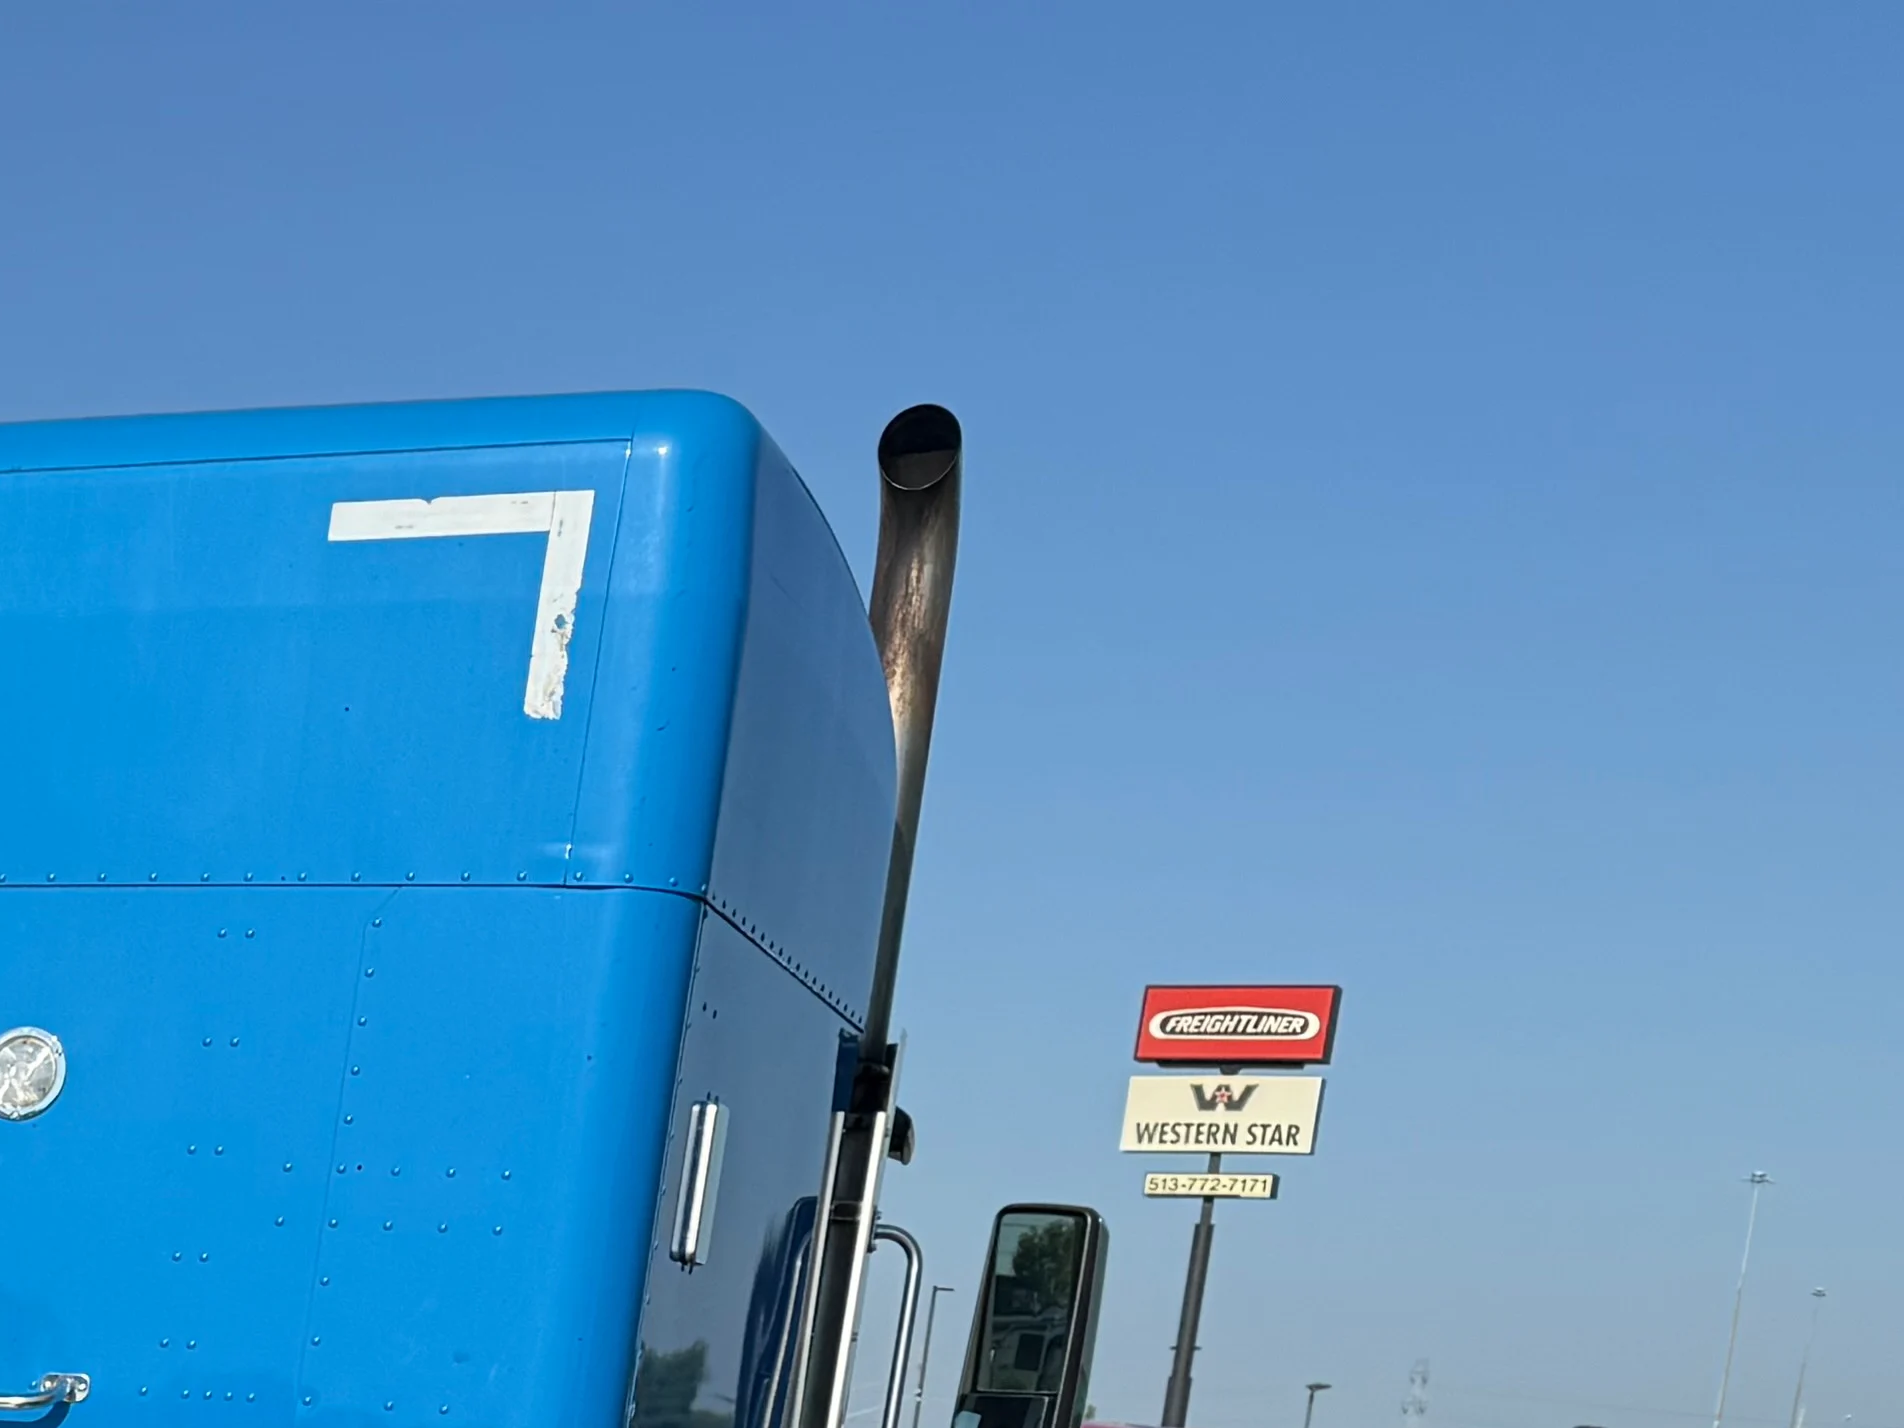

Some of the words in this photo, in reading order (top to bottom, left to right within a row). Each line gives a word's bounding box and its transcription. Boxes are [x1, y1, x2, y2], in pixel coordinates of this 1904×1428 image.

[1165, 1013, 1305, 1036] FREIGHTLINER
[1136, 1122, 1239, 1146] WESTERN
[1246, 1123, 1300, 1147] STAR
[1148, 1177, 1268, 1193] 513-772-7171
